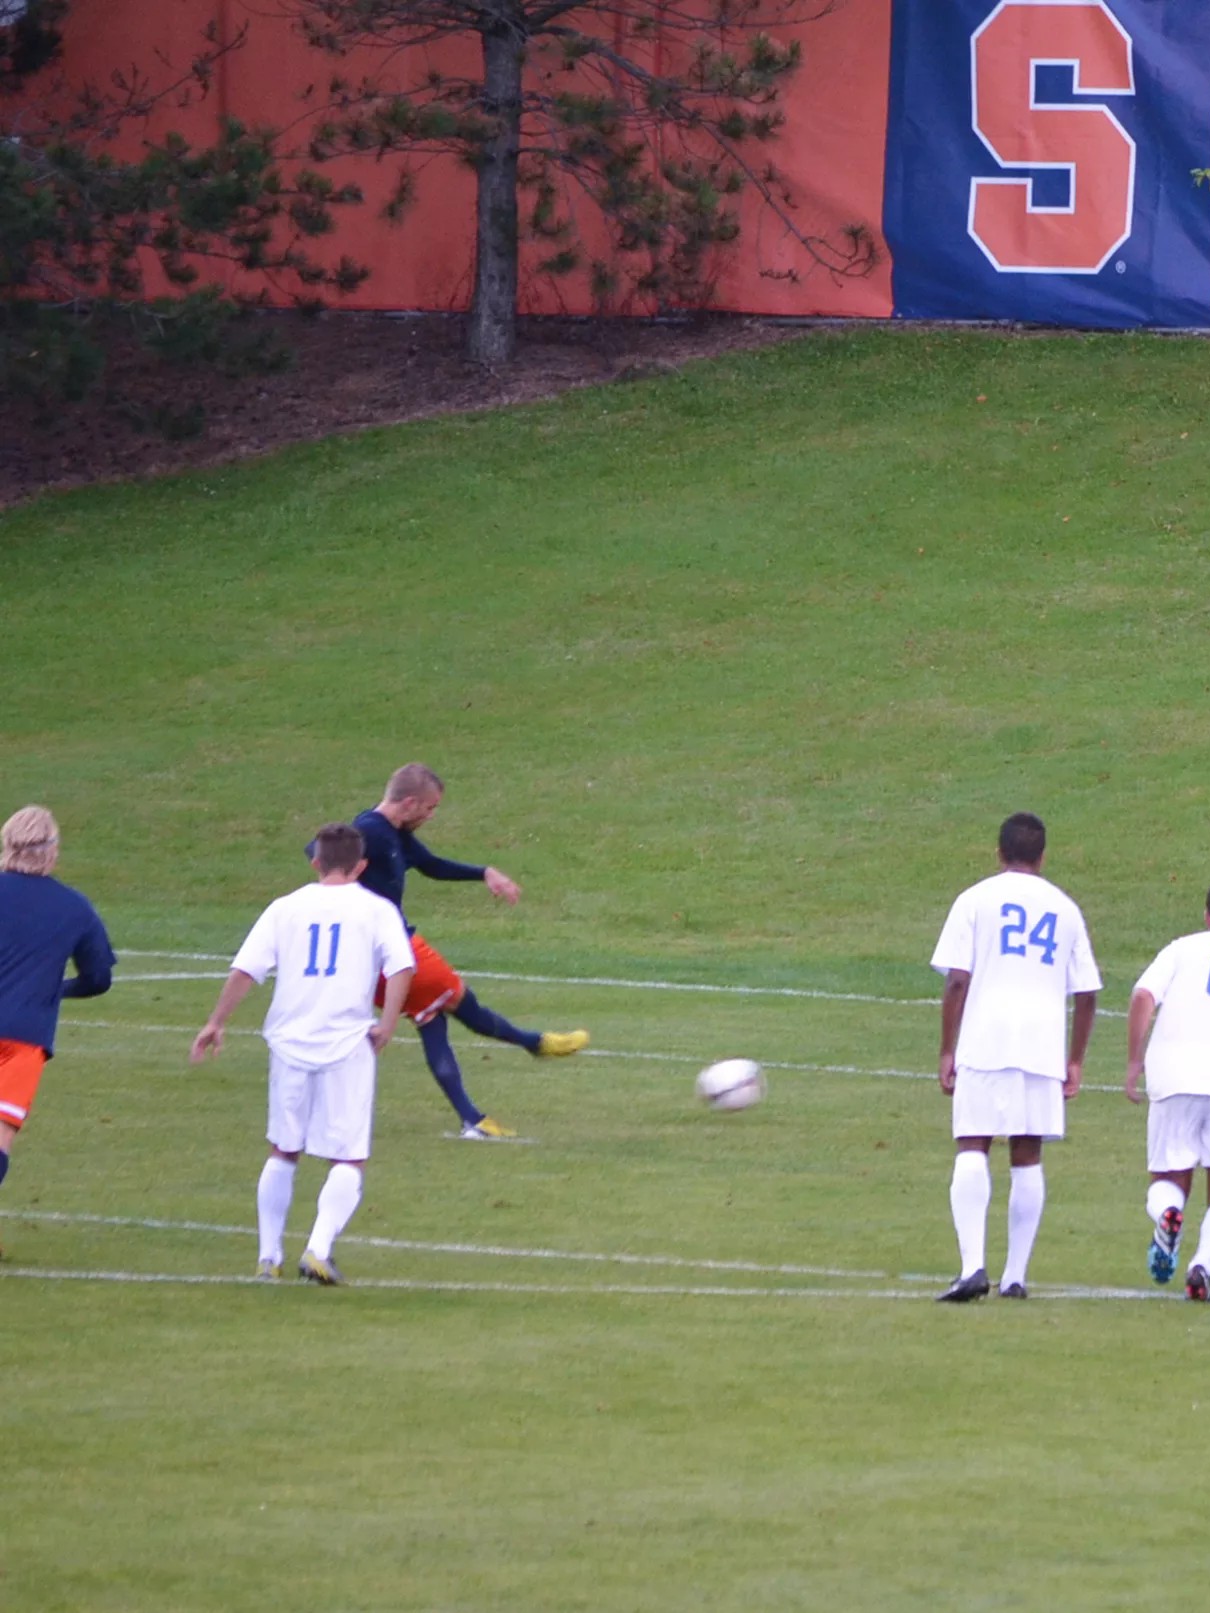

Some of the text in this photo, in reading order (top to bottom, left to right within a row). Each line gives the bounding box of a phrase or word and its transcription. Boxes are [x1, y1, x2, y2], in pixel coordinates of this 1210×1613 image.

[967, 0, 1136, 274] S
[304, 923, 341, 976] 11
[1000, 903, 1058, 965] 24
